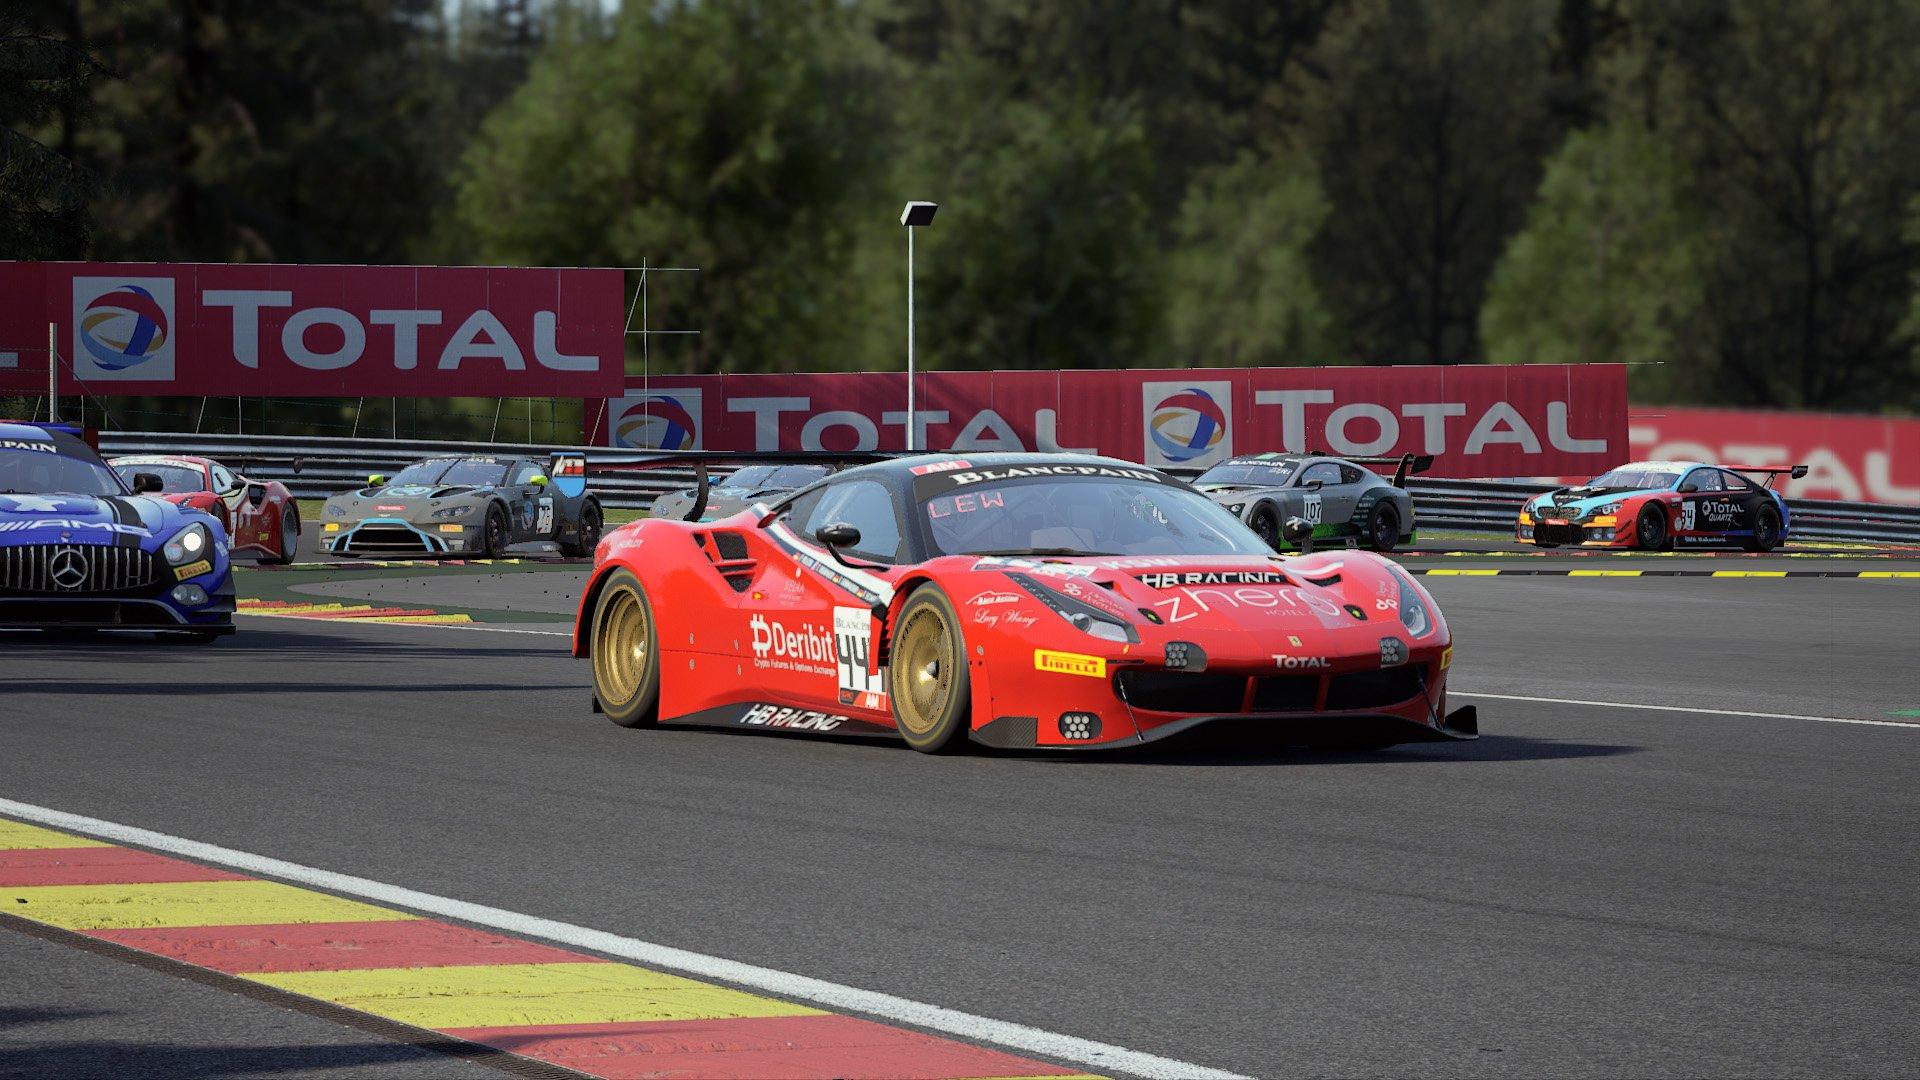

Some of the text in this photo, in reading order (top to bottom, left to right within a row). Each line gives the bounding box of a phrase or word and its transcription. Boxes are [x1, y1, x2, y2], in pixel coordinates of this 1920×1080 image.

[202, 289, 600, 371] TOTAL
[727, 396, 1098, 455] TOTAL
[1255, 389, 1608, 456] TOTAL
[0, 440, 57, 454] PAIN
[924, 461, 960, 473] AM
[1629, 427, 1920, 503] TAL
[949, 465, 1162, 486] BLANCPAIN
[1305, 502, 1321, 520] 107
[1710, 501, 1745, 514] TOTAL
[1142, 572, 1179, 589] HB
[772, 620, 836, 664] Deribit
[1271, 653, 1332, 669] TOTAL
